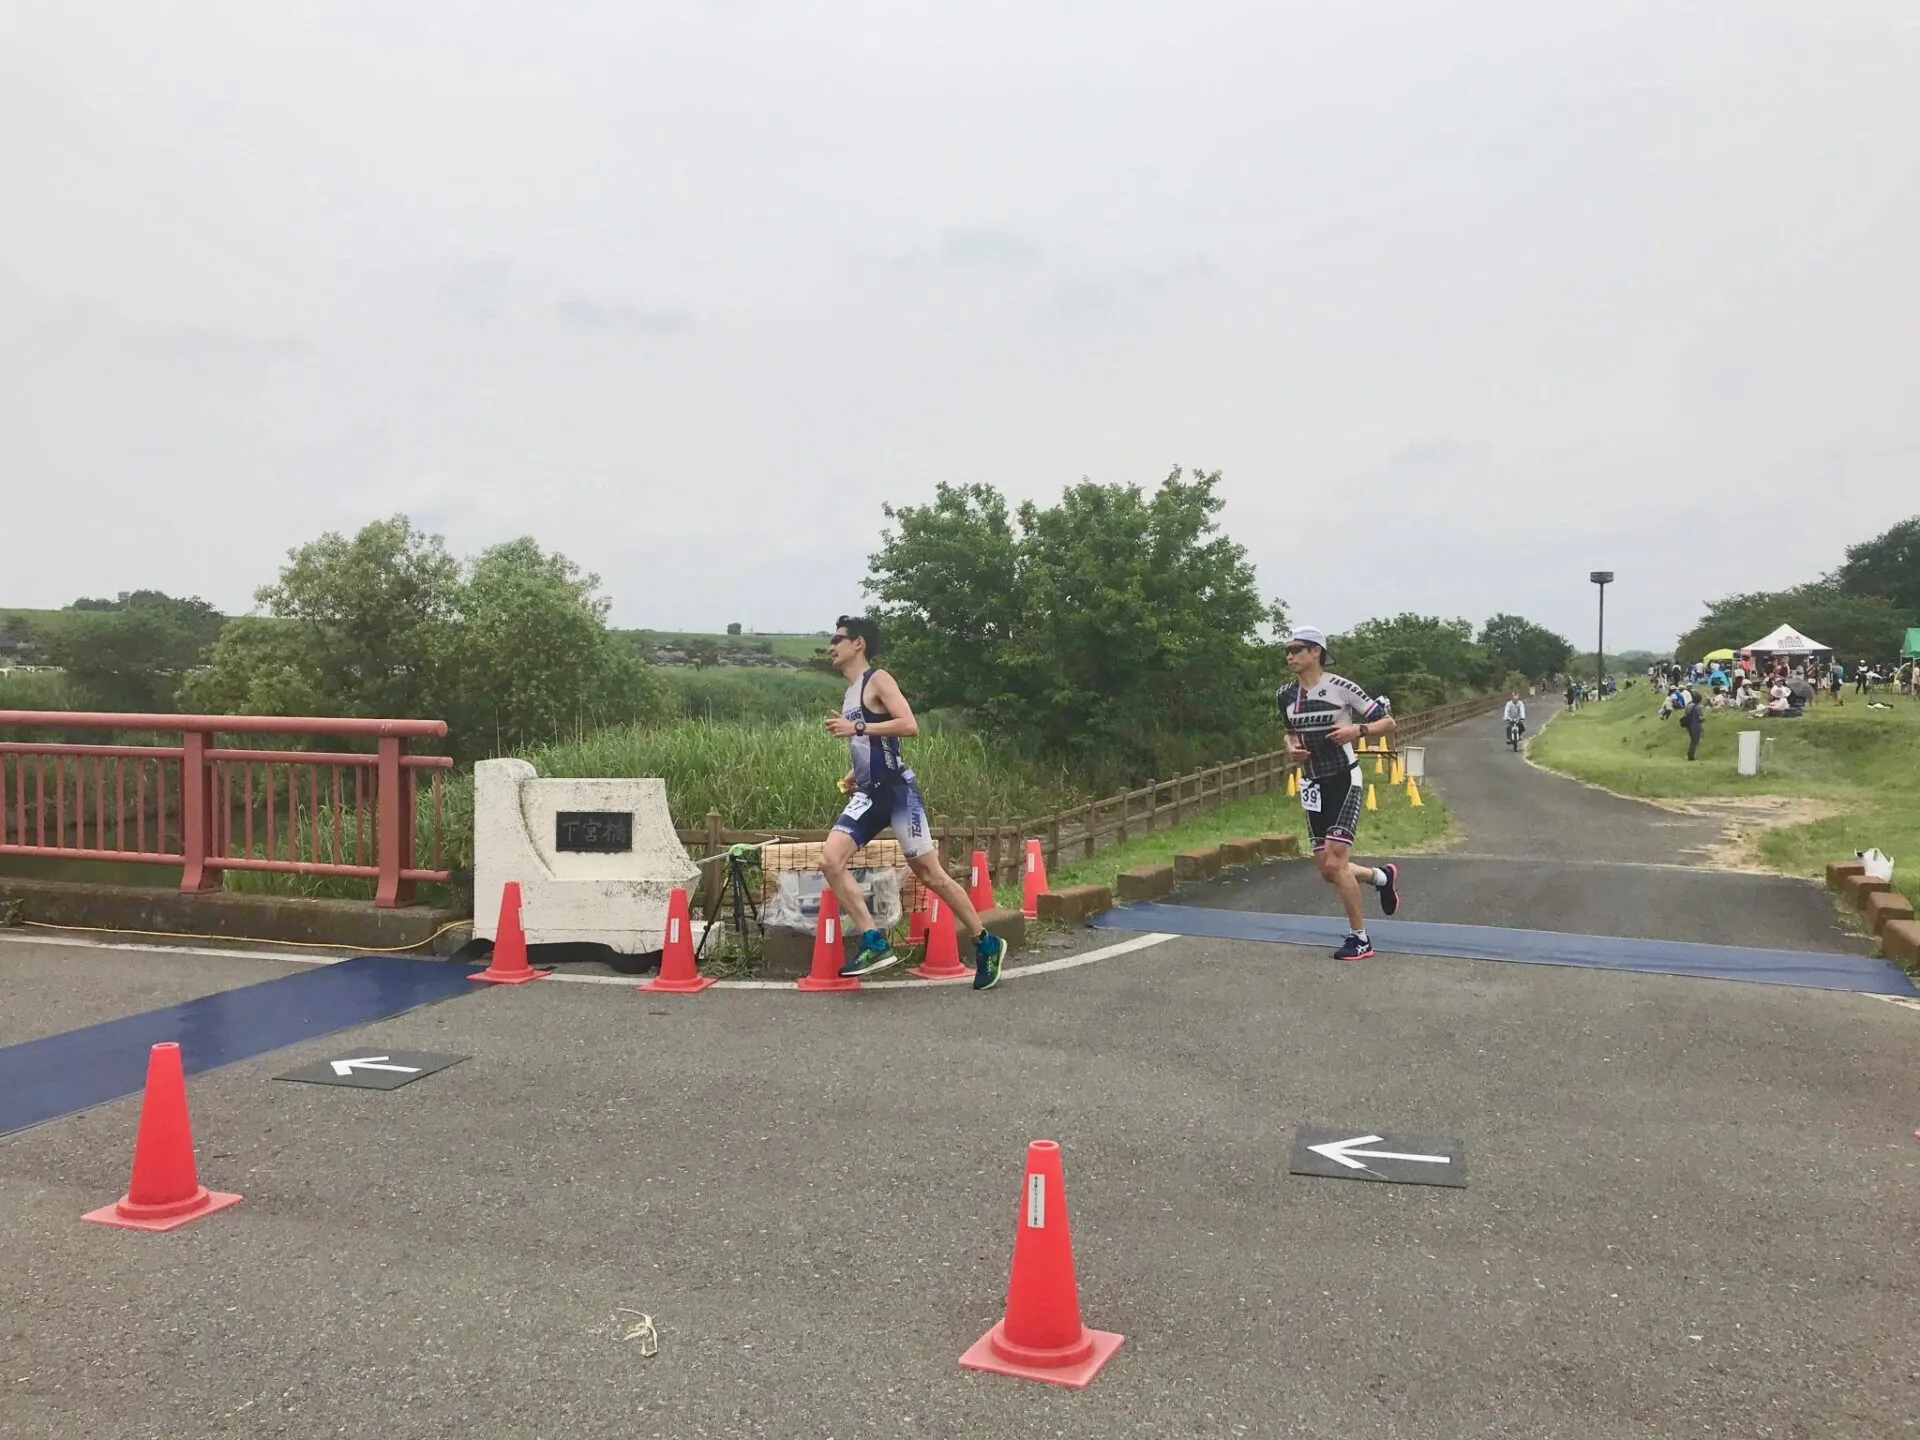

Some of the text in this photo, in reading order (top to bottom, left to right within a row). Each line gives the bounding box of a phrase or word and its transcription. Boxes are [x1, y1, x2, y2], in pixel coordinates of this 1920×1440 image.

[1329, 676, 1371, 702] TAKASAKI
[1302, 788, 1317, 803] 39
[911, 813, 922, 838] TEAM
